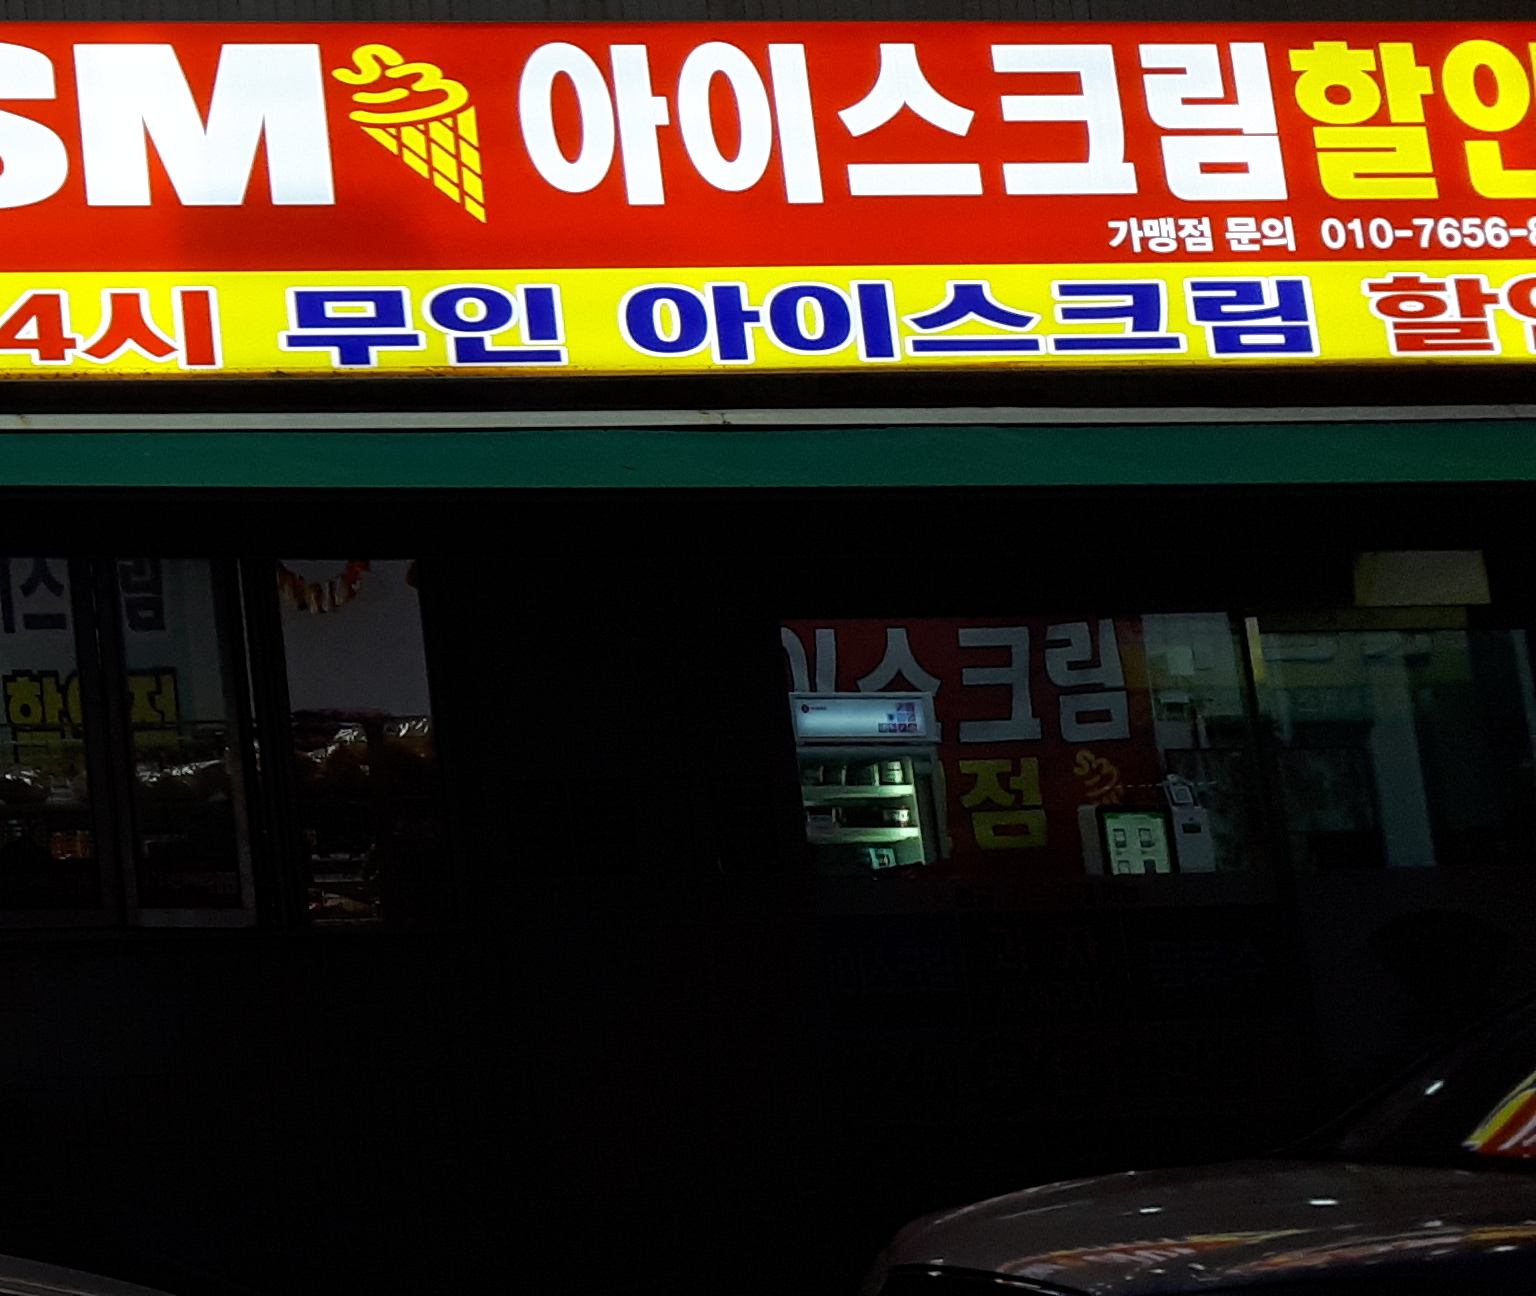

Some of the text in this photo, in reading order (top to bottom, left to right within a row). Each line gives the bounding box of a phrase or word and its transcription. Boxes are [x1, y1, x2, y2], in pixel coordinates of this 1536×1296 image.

[1108, 216, 1214, 253] 가맹점
[1225, 215, 1297, 253] 문의
[278, 281, 570, 368] 무인
[618, 275, 1320, 368] 아이스크림
